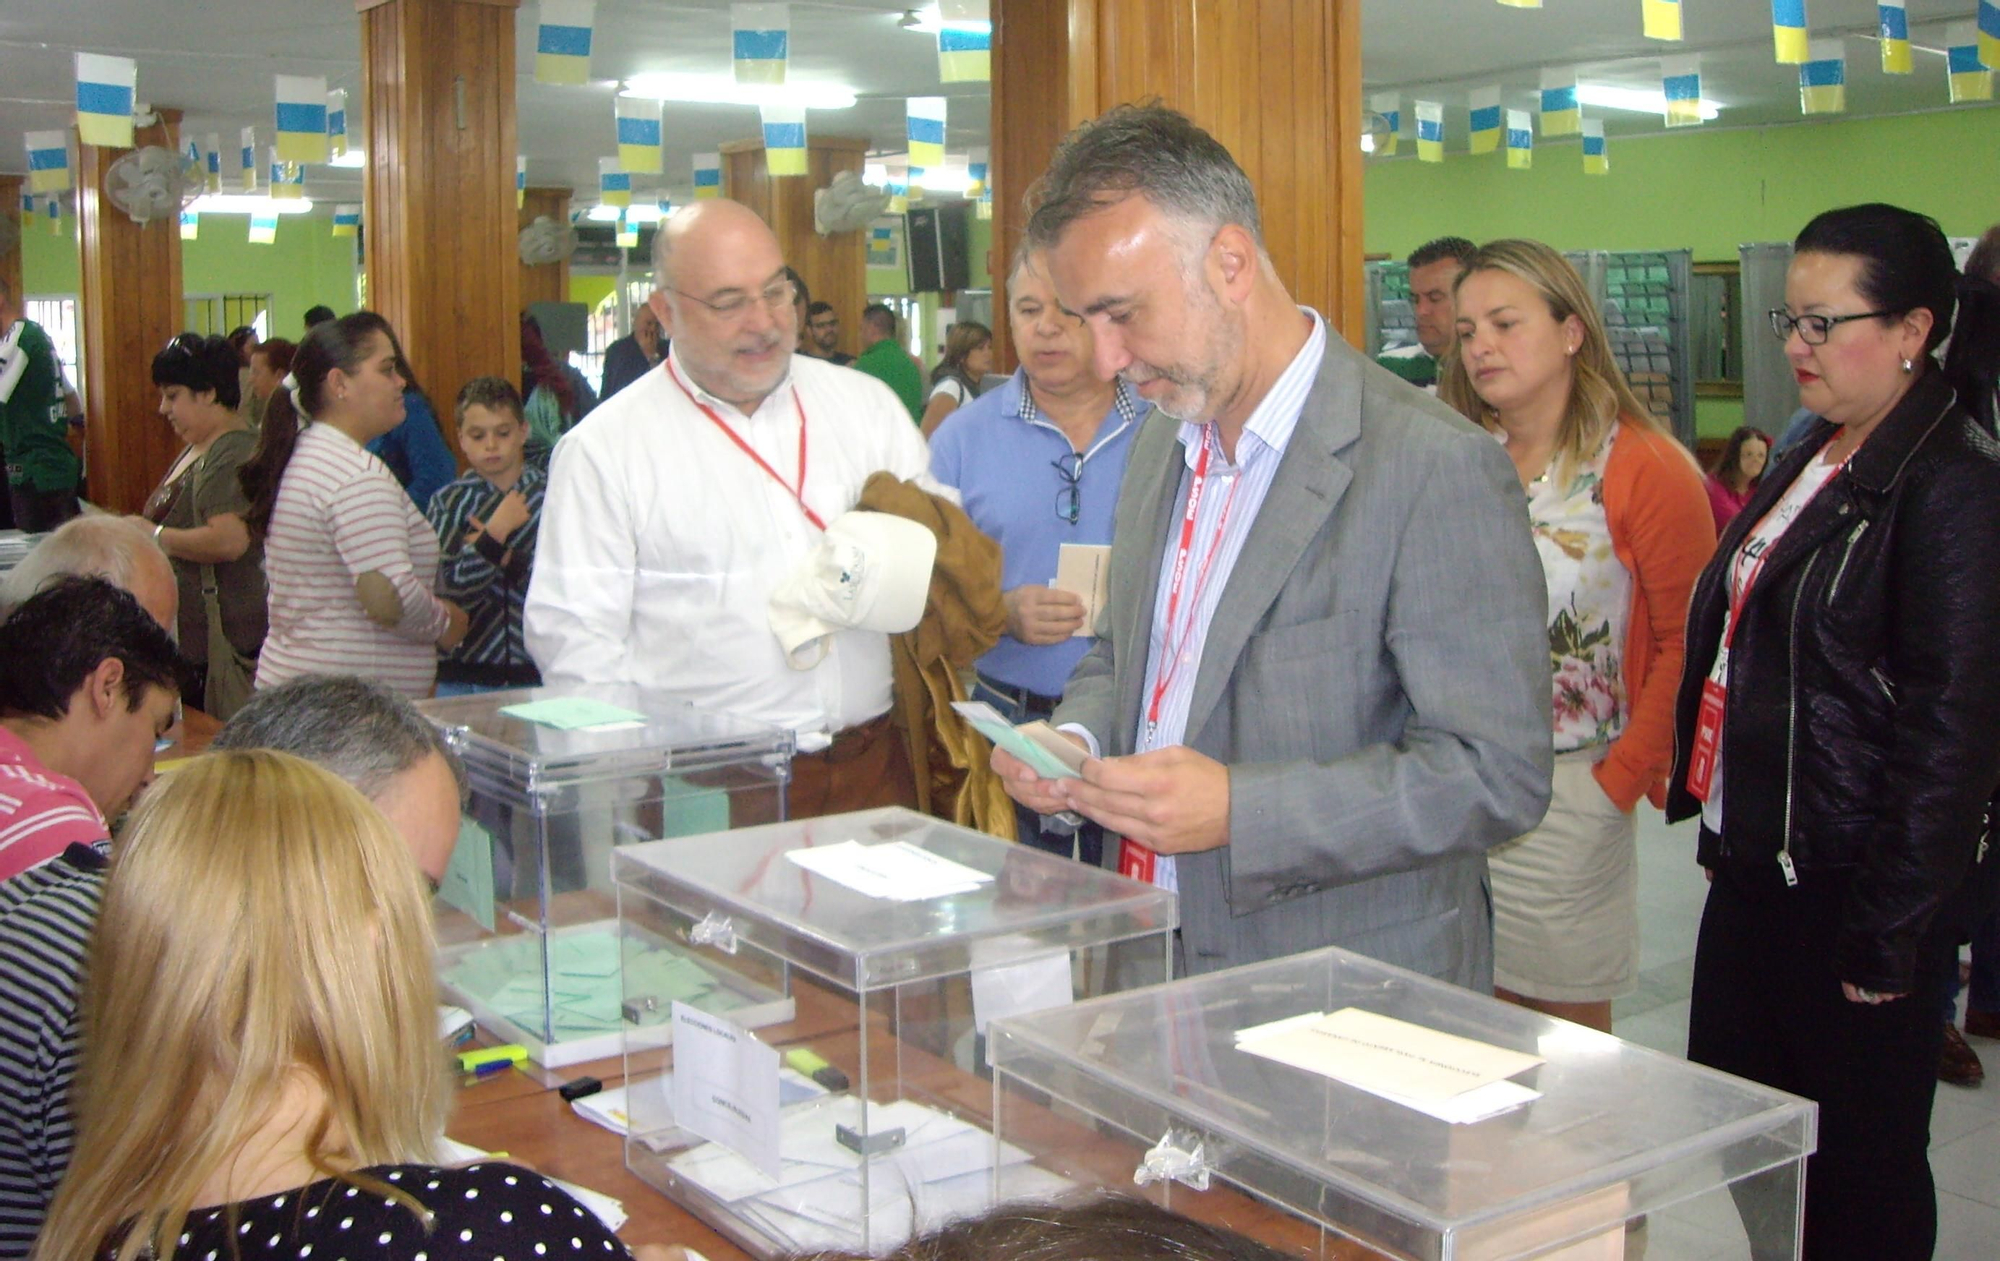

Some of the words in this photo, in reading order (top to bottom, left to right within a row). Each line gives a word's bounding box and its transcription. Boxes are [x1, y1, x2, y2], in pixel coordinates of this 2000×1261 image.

[1204, 421, 1213, 450] SOE
[1186, 476, 1203, 521] PSOE
[1172, 548, 1187, 594] PSOE
